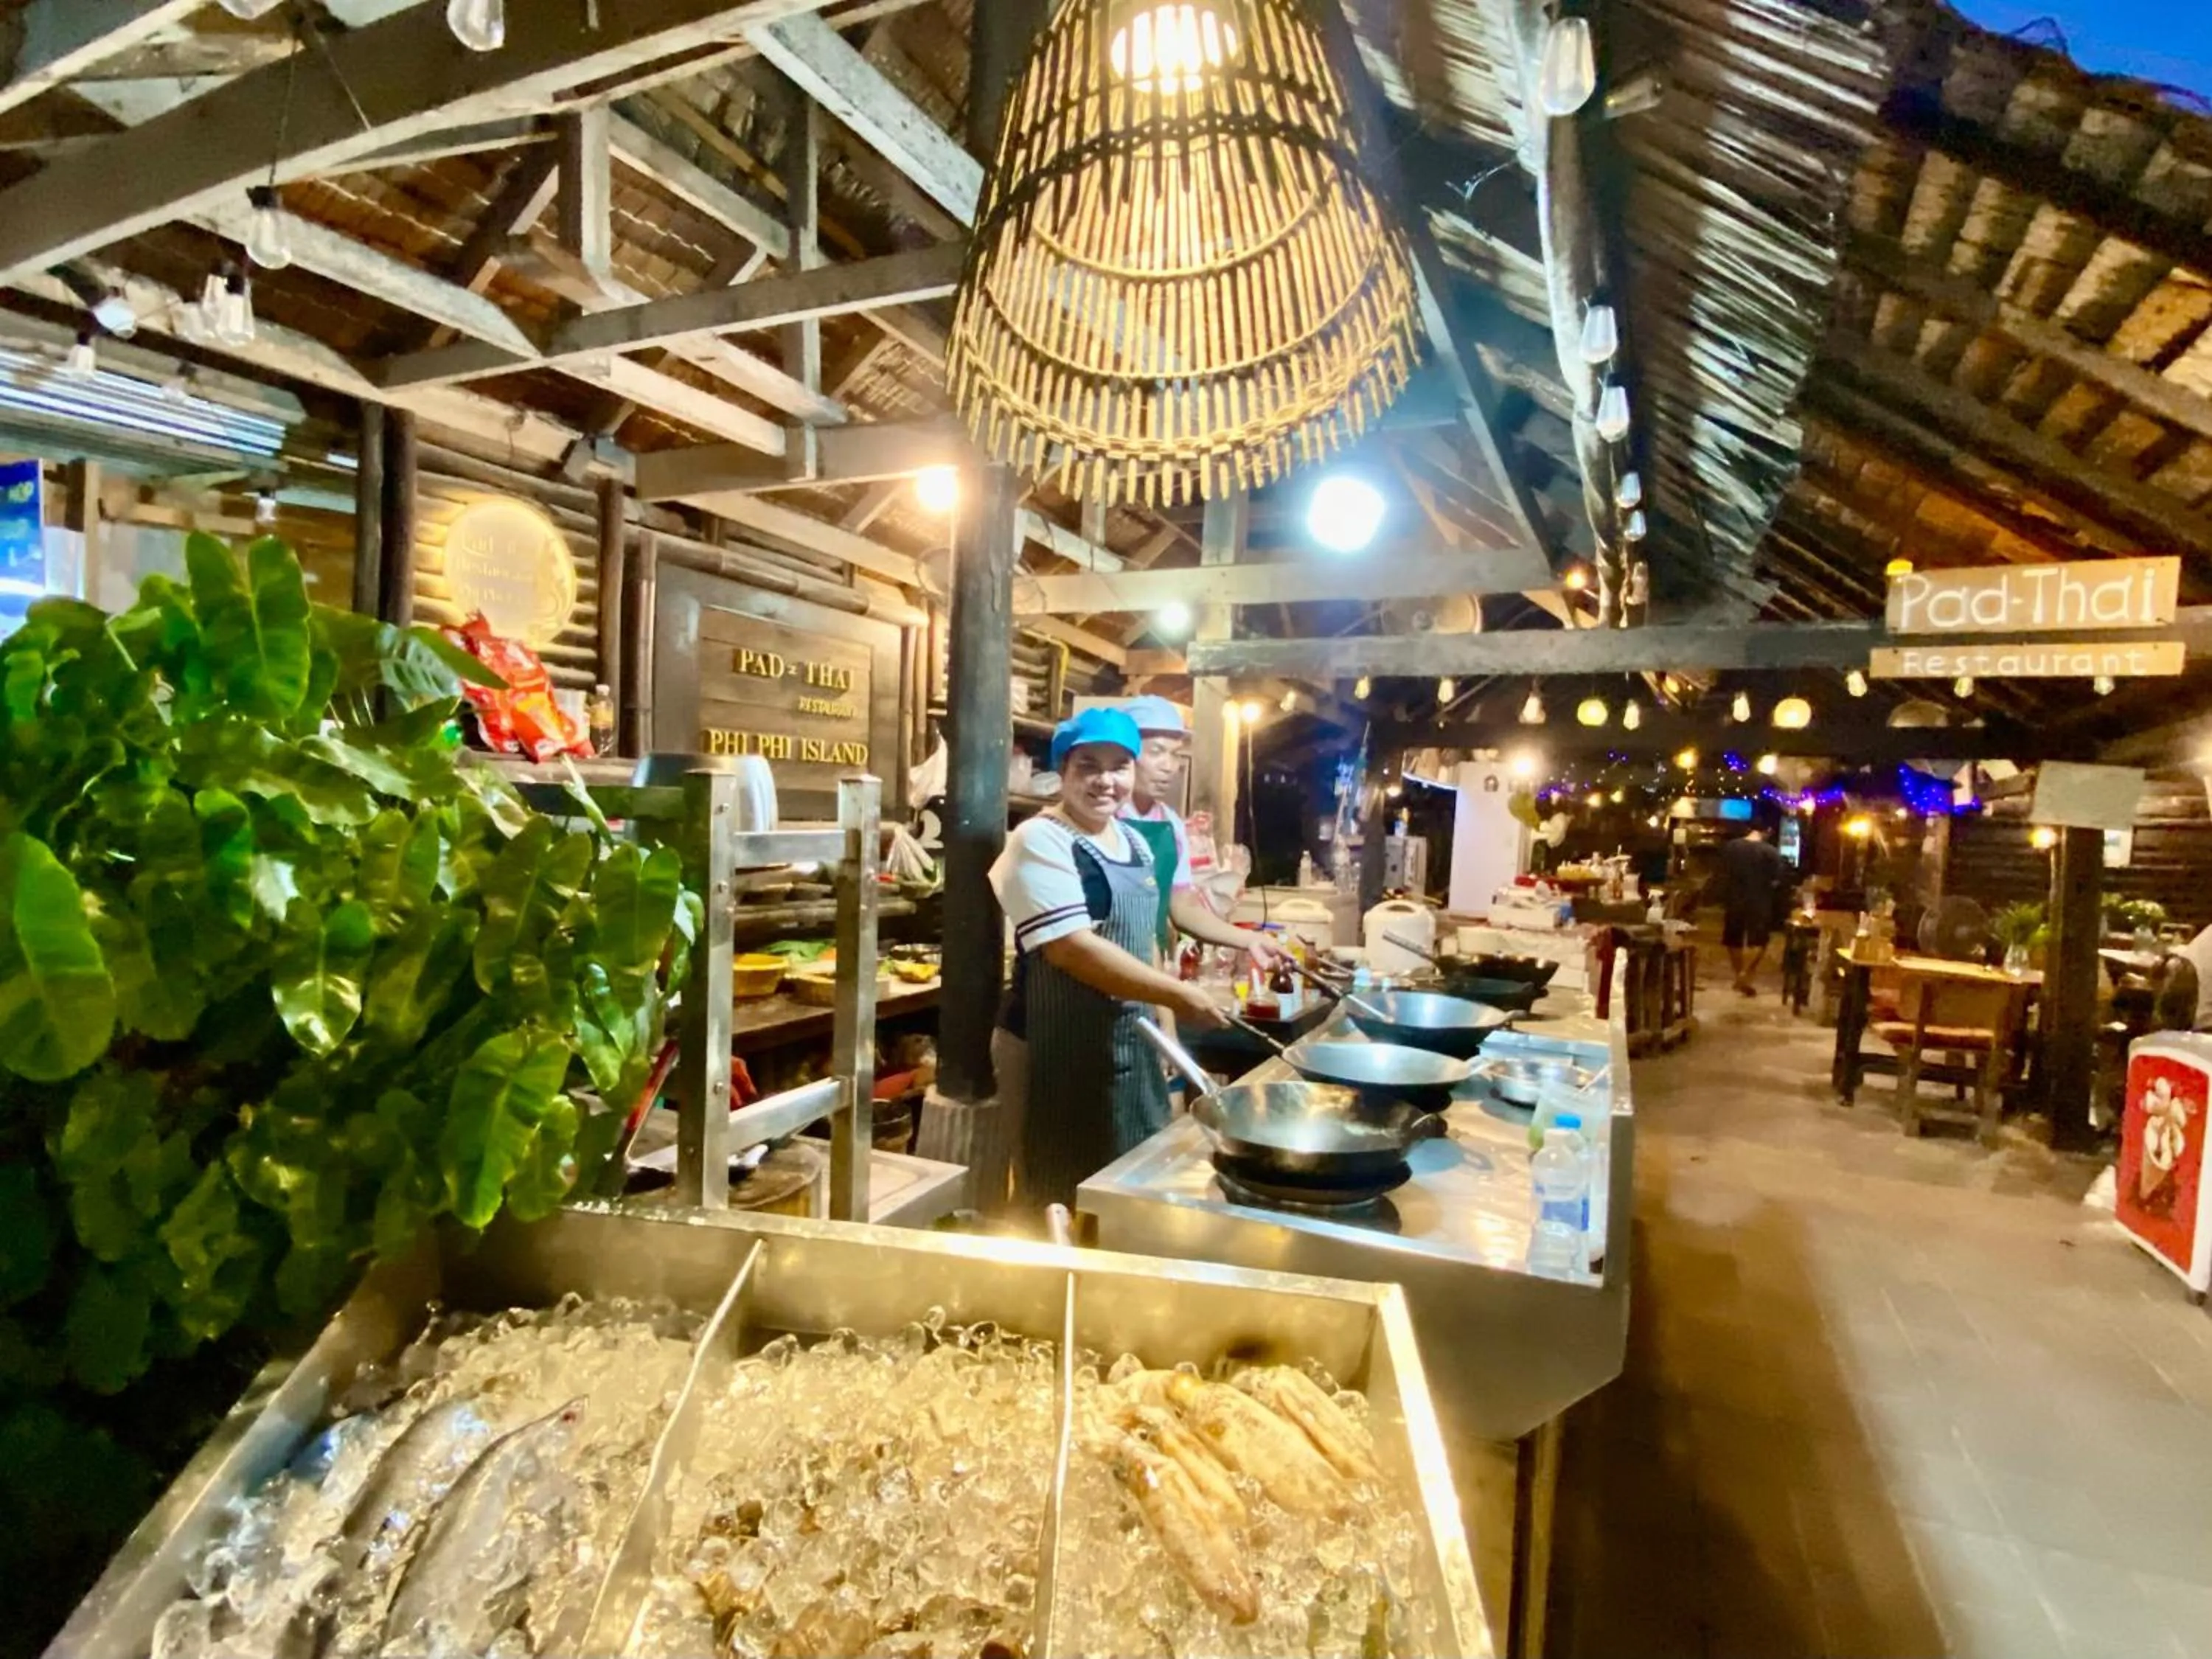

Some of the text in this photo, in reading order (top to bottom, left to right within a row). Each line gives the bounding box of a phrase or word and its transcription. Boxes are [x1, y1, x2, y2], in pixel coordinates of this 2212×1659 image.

[1897, 566, 2156, 630] Pad-Thai
[1902, 650, 2148, 676] Restaurant
[709, 728, 869, 765] PHI PHI ISLAND
